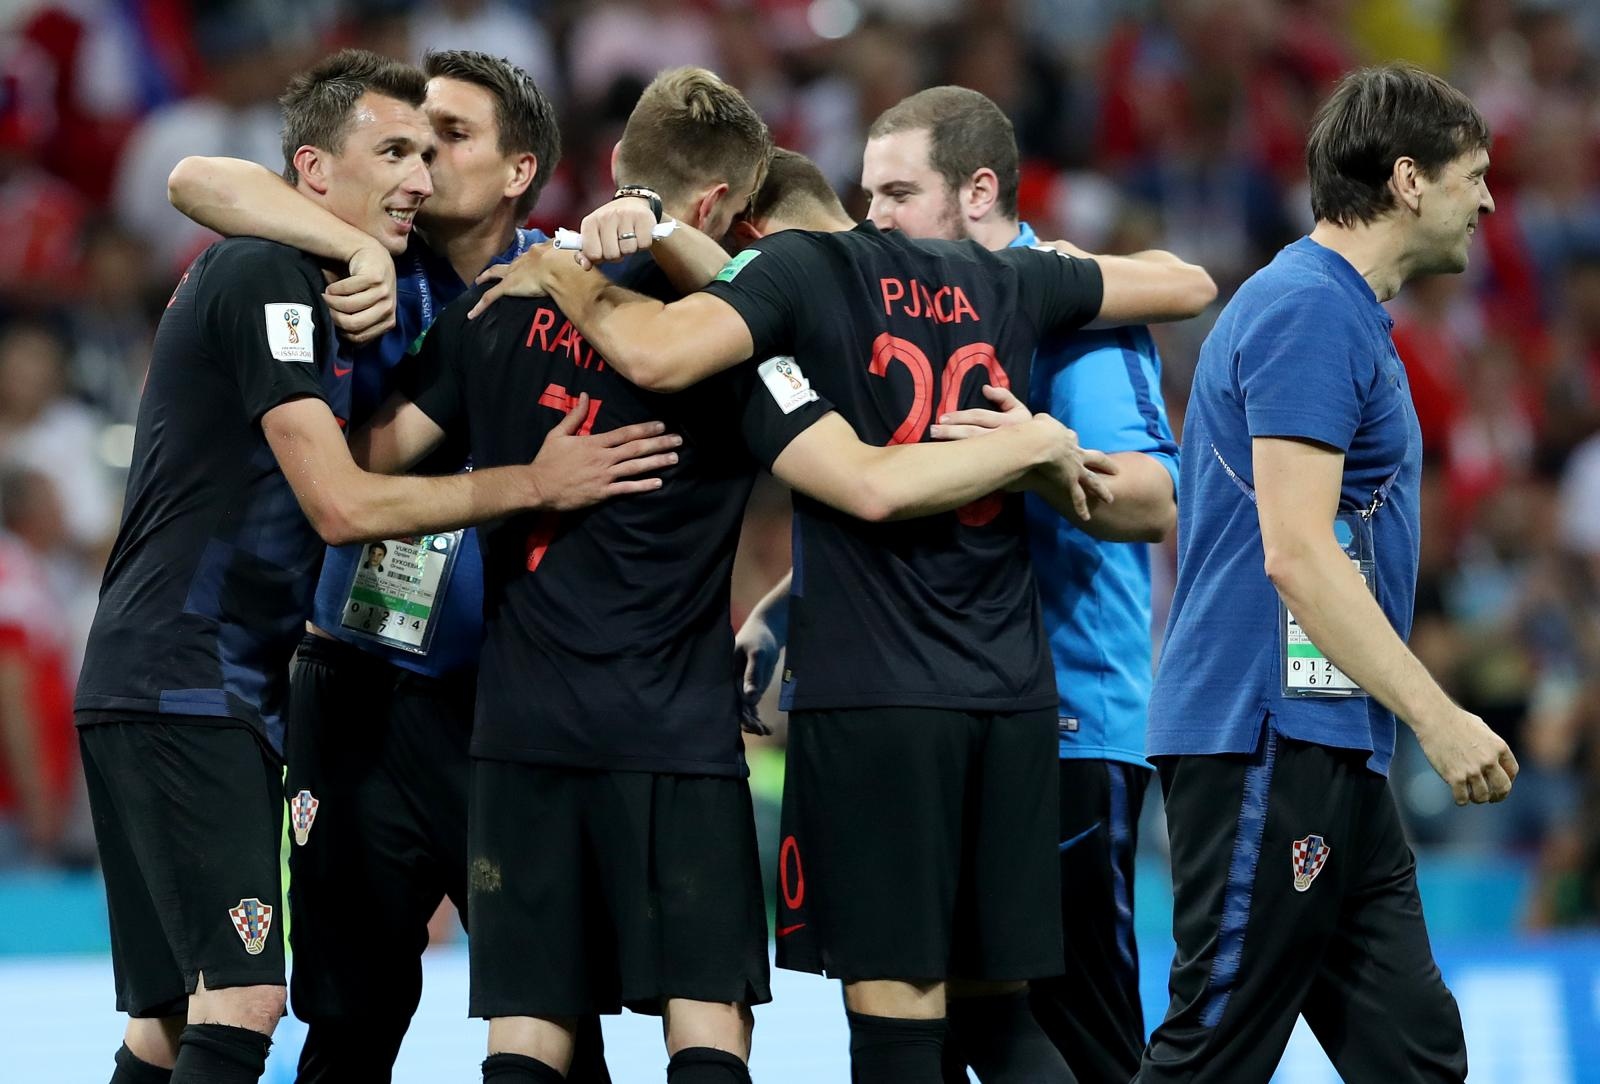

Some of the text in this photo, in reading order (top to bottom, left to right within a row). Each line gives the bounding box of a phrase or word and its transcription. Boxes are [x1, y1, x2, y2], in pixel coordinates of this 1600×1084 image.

[880, 277, 980, 324] PJACA
[351, 602, 420, 630] 0 1 2 3 4
[363, 619, 386, 633] 6 7
[1293, 661, 1332, 671] 0 1 2
[1309, 674, 1332, 684] 6 7
